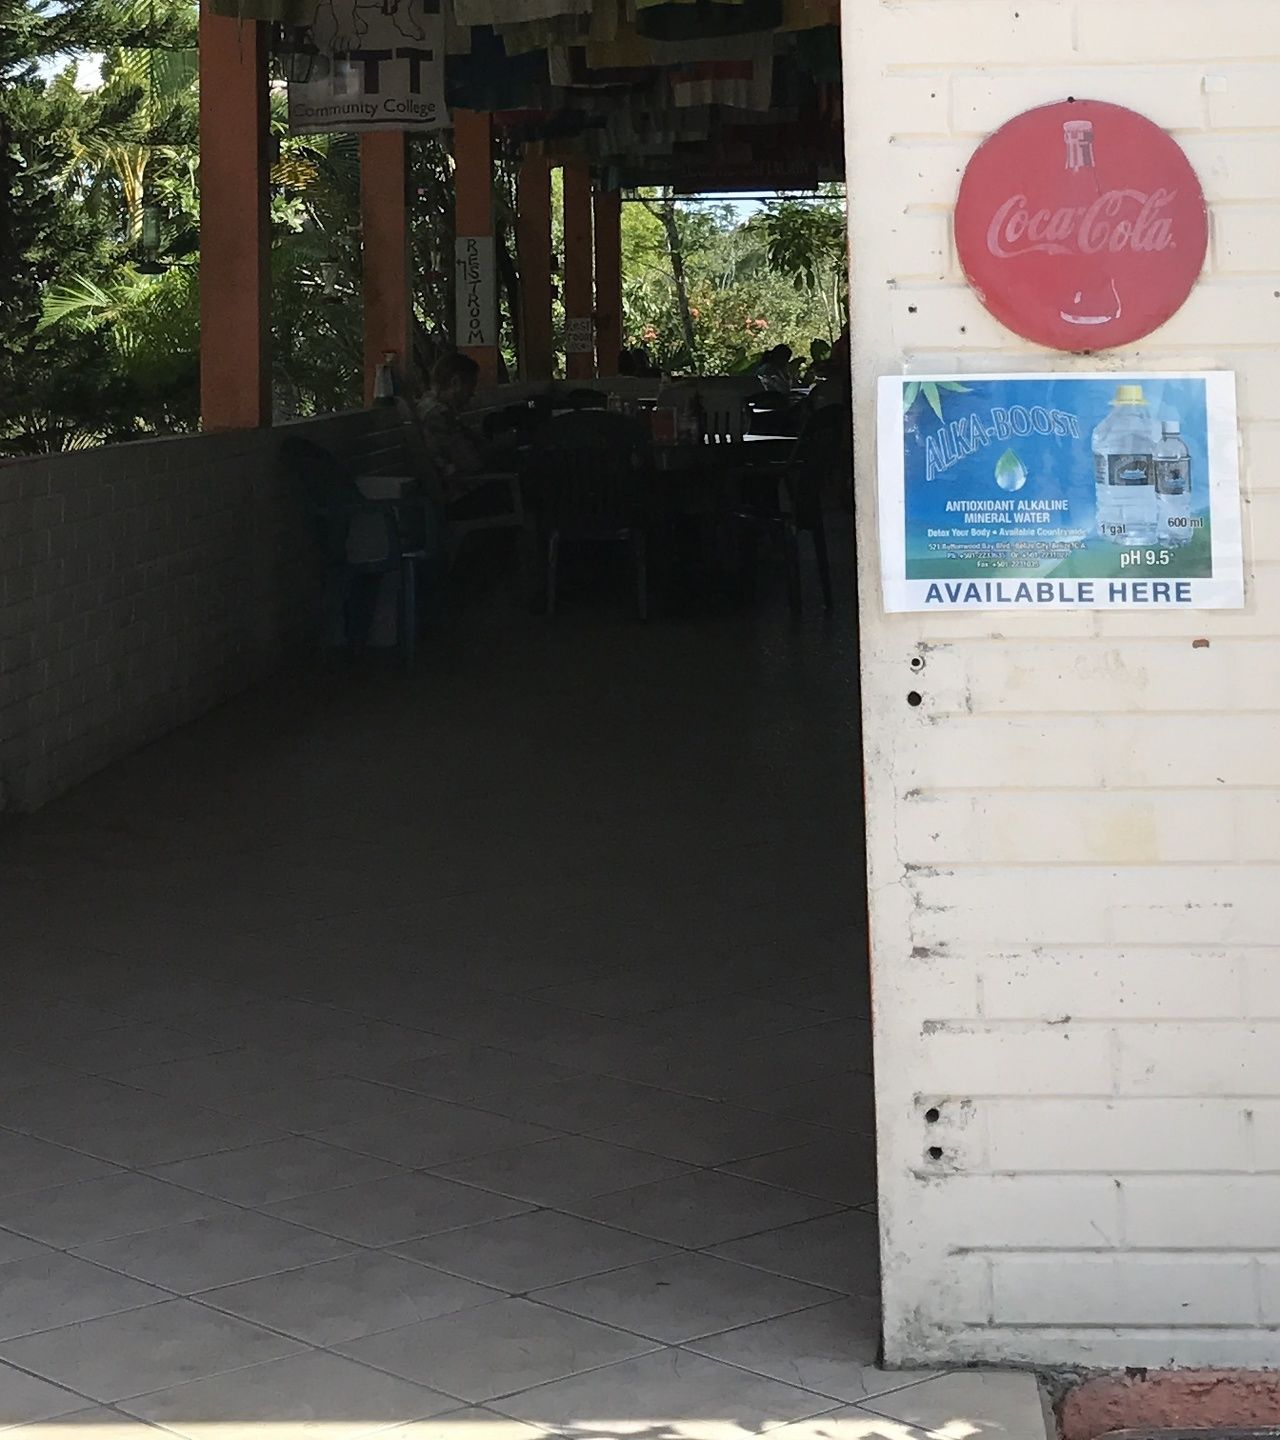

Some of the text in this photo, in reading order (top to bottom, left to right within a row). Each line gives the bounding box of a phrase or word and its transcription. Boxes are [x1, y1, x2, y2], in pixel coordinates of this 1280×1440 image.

[294, 99, 436, 118] Community College
[467, 239, 484, 344] RESTROOM
[925, 405, 1080, 481] ALKA-BOOST
[946, 500, 1068, 511] ANTIOXIDANT ALKALINE
[964, 513, 1050, 523] MINERAL WATER
[1168, 517, 1203, 527] 600 ml
[927, 529, 949, 537] Detox
[971, 528, 990, 537] Body
[1110, 525, 1126, 535] gal
[1121, 551, 1141, 568] pH
[925, 582, 1192, 603] AVAILABLE HERE
